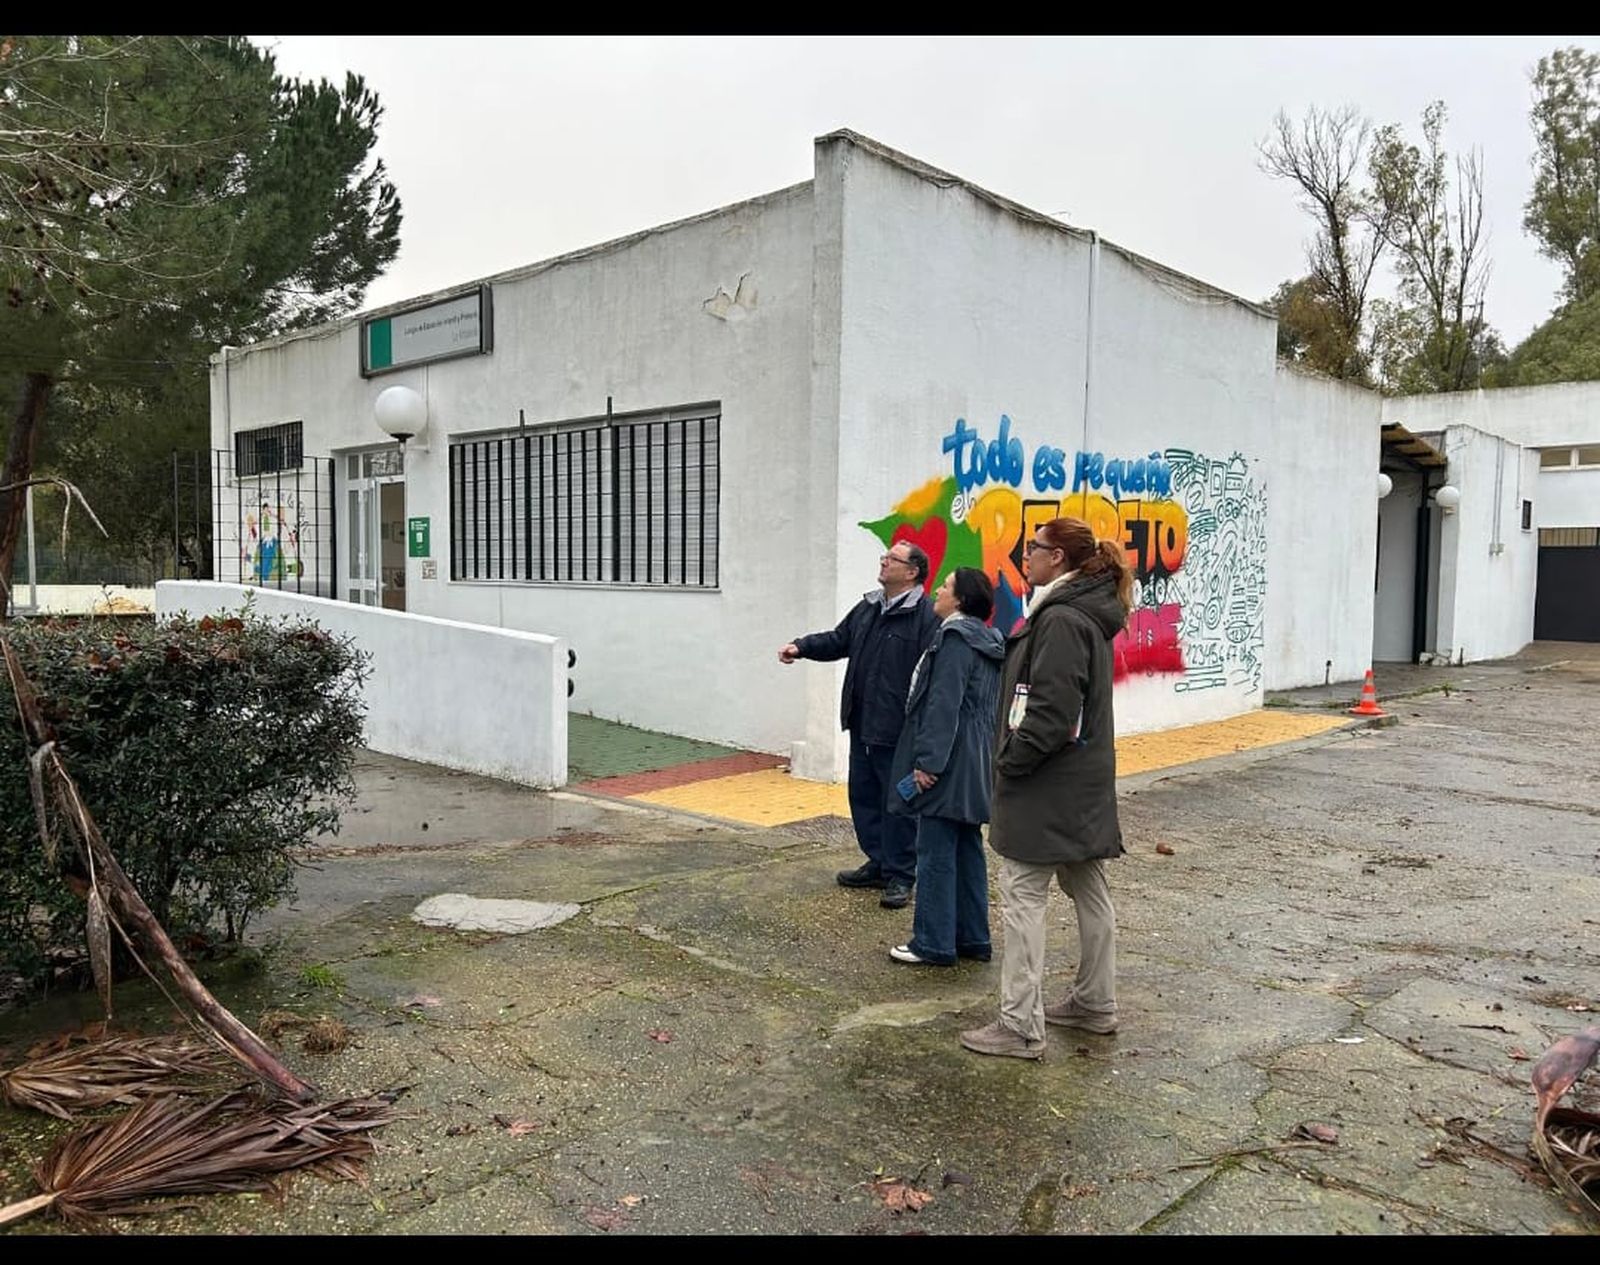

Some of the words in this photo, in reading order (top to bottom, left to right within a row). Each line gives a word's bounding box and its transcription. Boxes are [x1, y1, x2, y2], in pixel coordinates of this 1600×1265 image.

[943, 414, 1024, 493] todo
[1032, 445, 1066, 493] es
[966, 488, 1188, 597] REPETO
